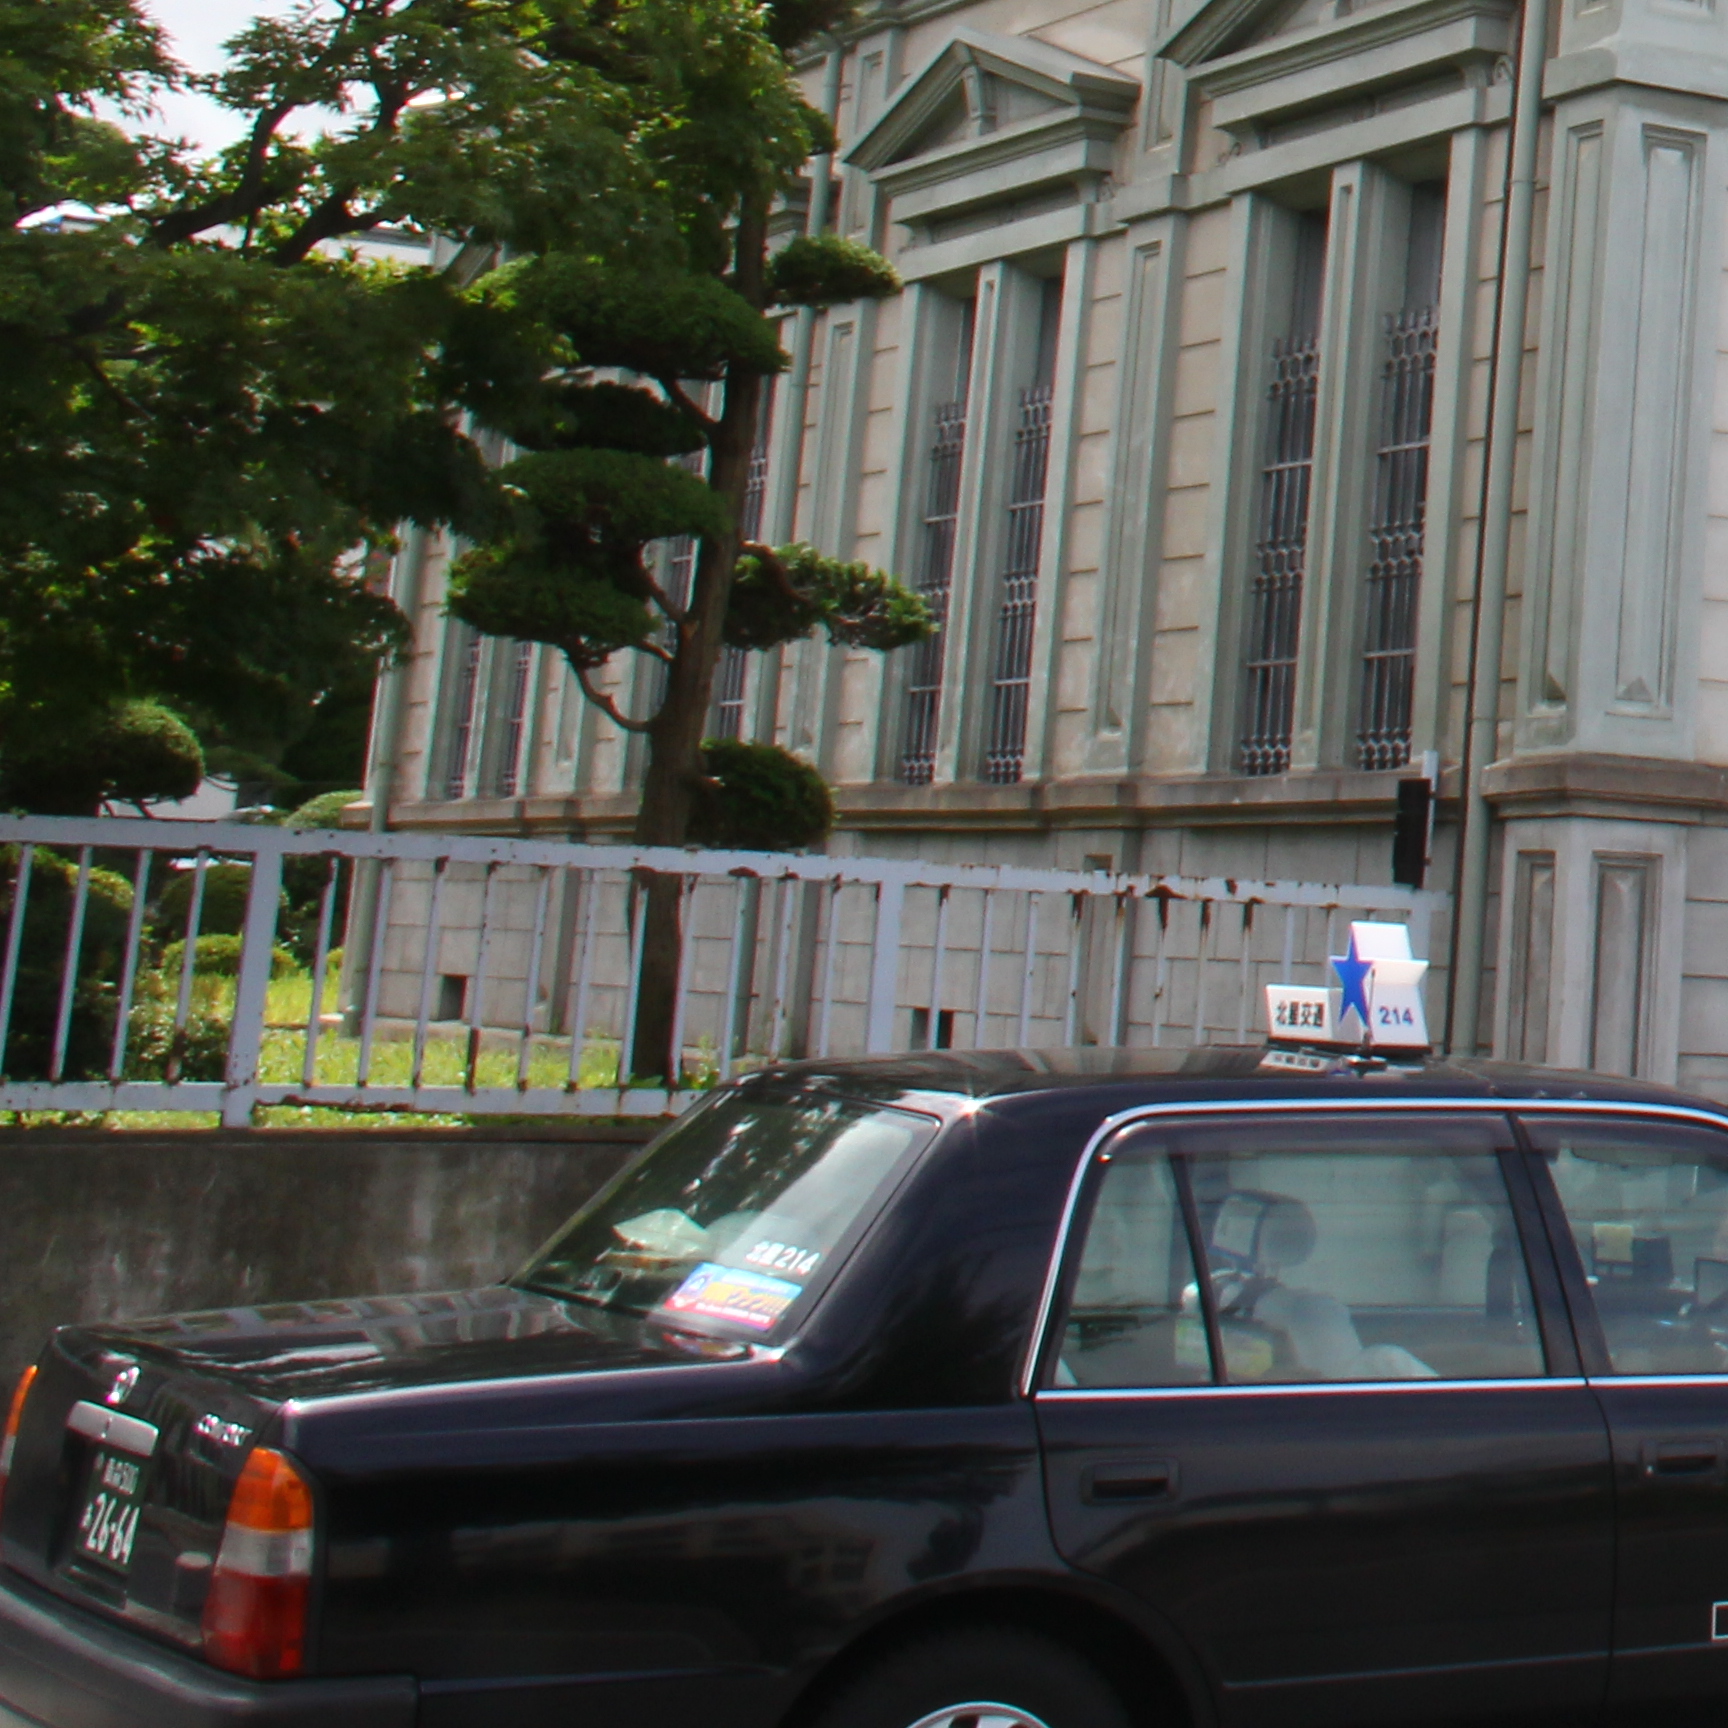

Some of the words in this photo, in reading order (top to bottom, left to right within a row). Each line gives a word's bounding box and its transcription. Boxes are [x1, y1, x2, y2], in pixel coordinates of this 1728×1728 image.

[1275, 1001, 1326, 1028] 北星交通
[1380, 1006, 1414, 1026] 214
